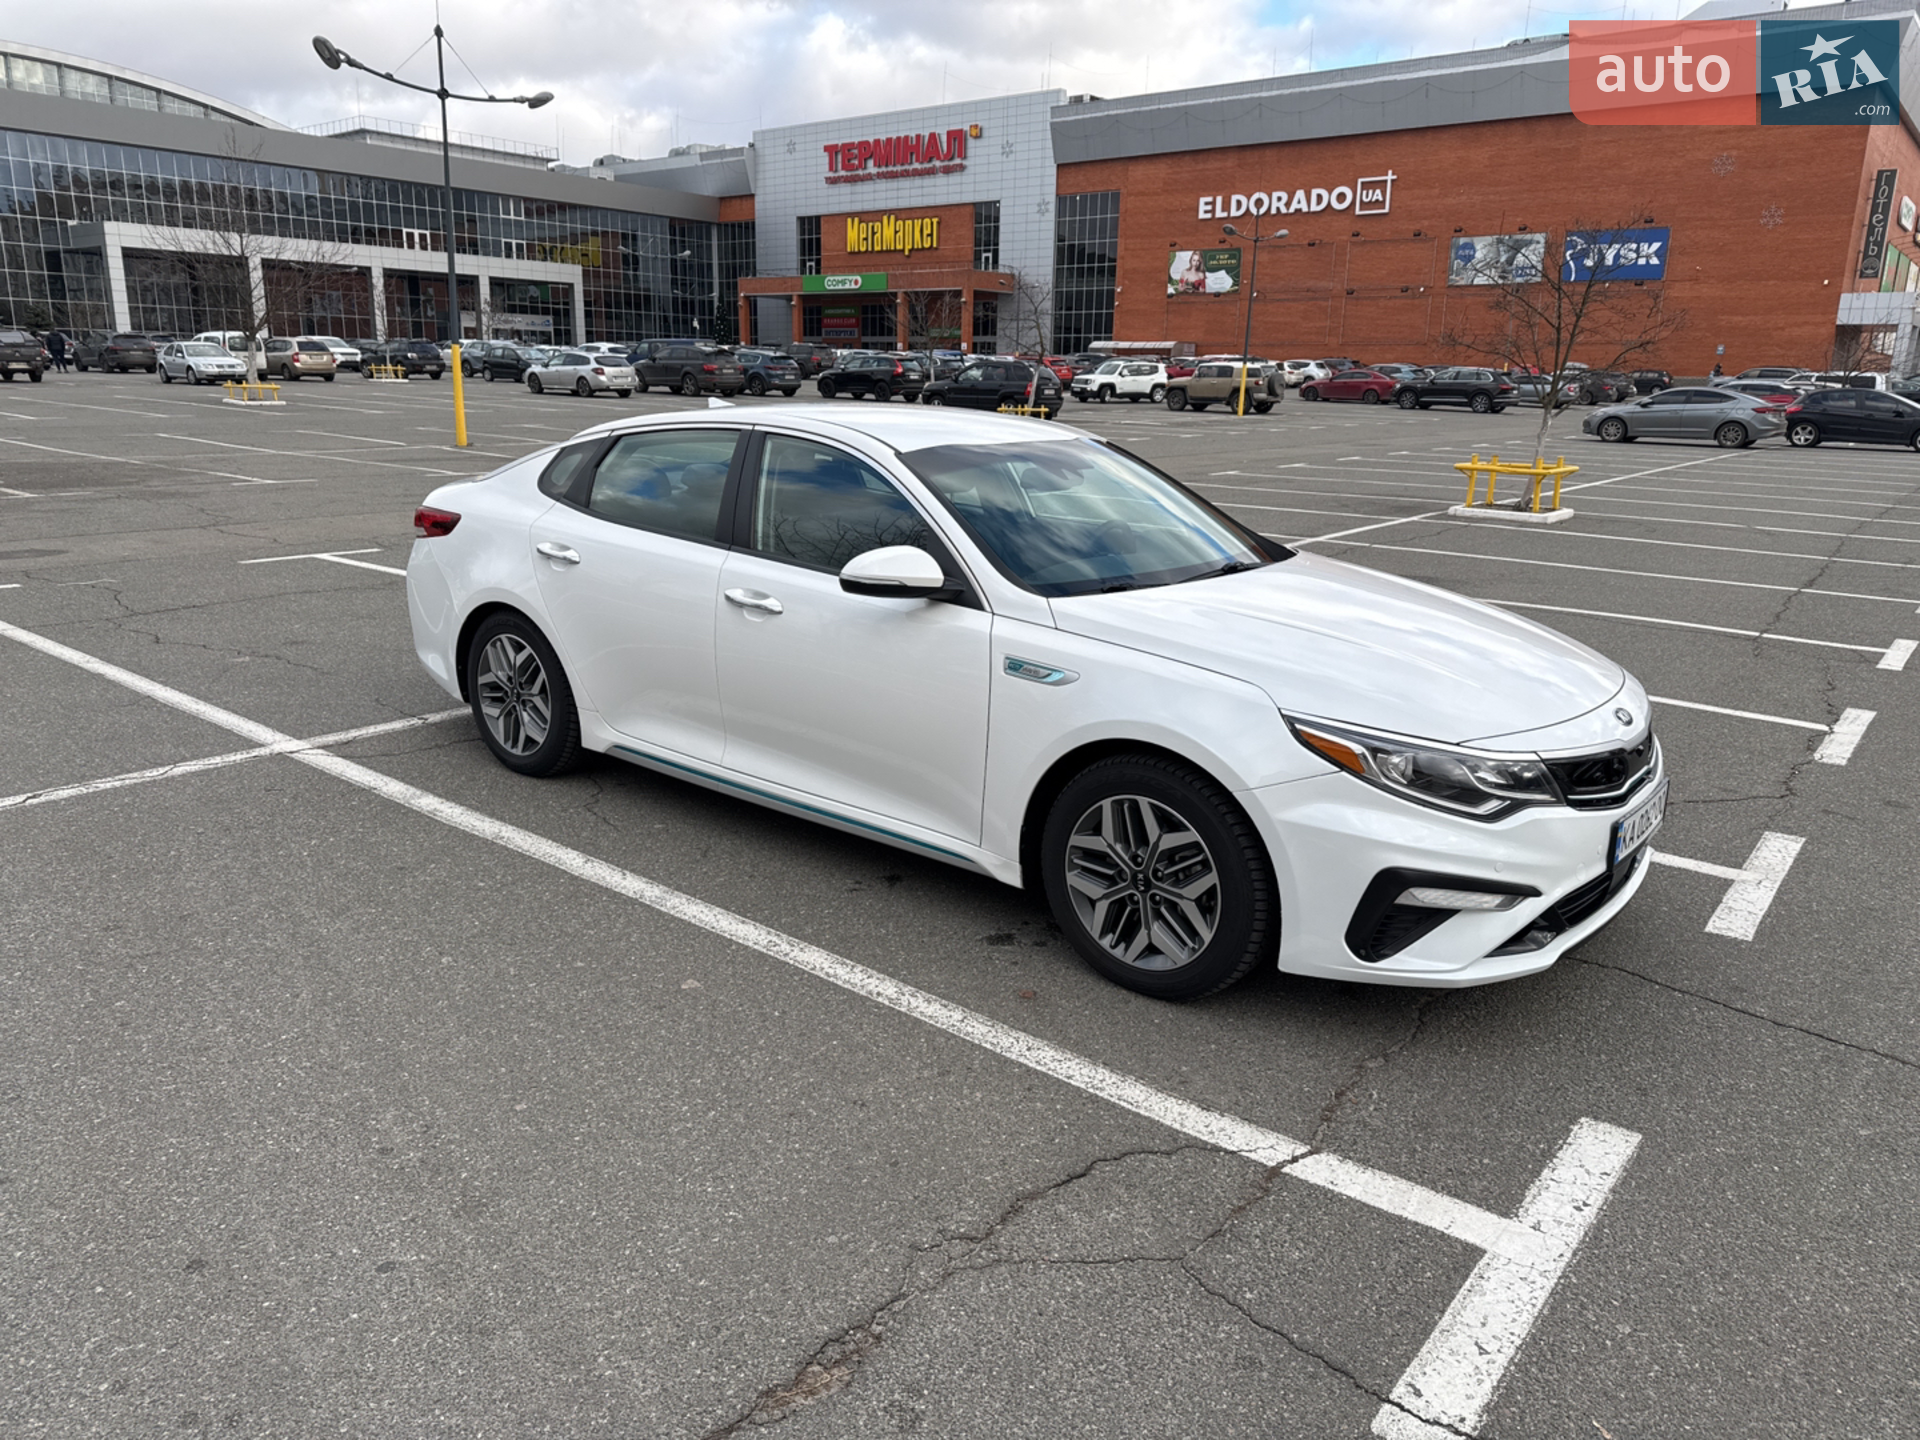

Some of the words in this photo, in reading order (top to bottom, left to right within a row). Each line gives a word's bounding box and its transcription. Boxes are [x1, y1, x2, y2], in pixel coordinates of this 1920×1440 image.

[824, 128, 967, 172] ТЕРМІНАЛ
[1198, 186, 1353, 220] ELDORADO
[1361, 188, 1383, 202] UA
[847, 214, 940, 256] МегаМаркет
[1583, 242, 1663, 267] JYSK
[826, 277, 854, 289] COMFY
[1137, 873, 1145, 892] KIA
